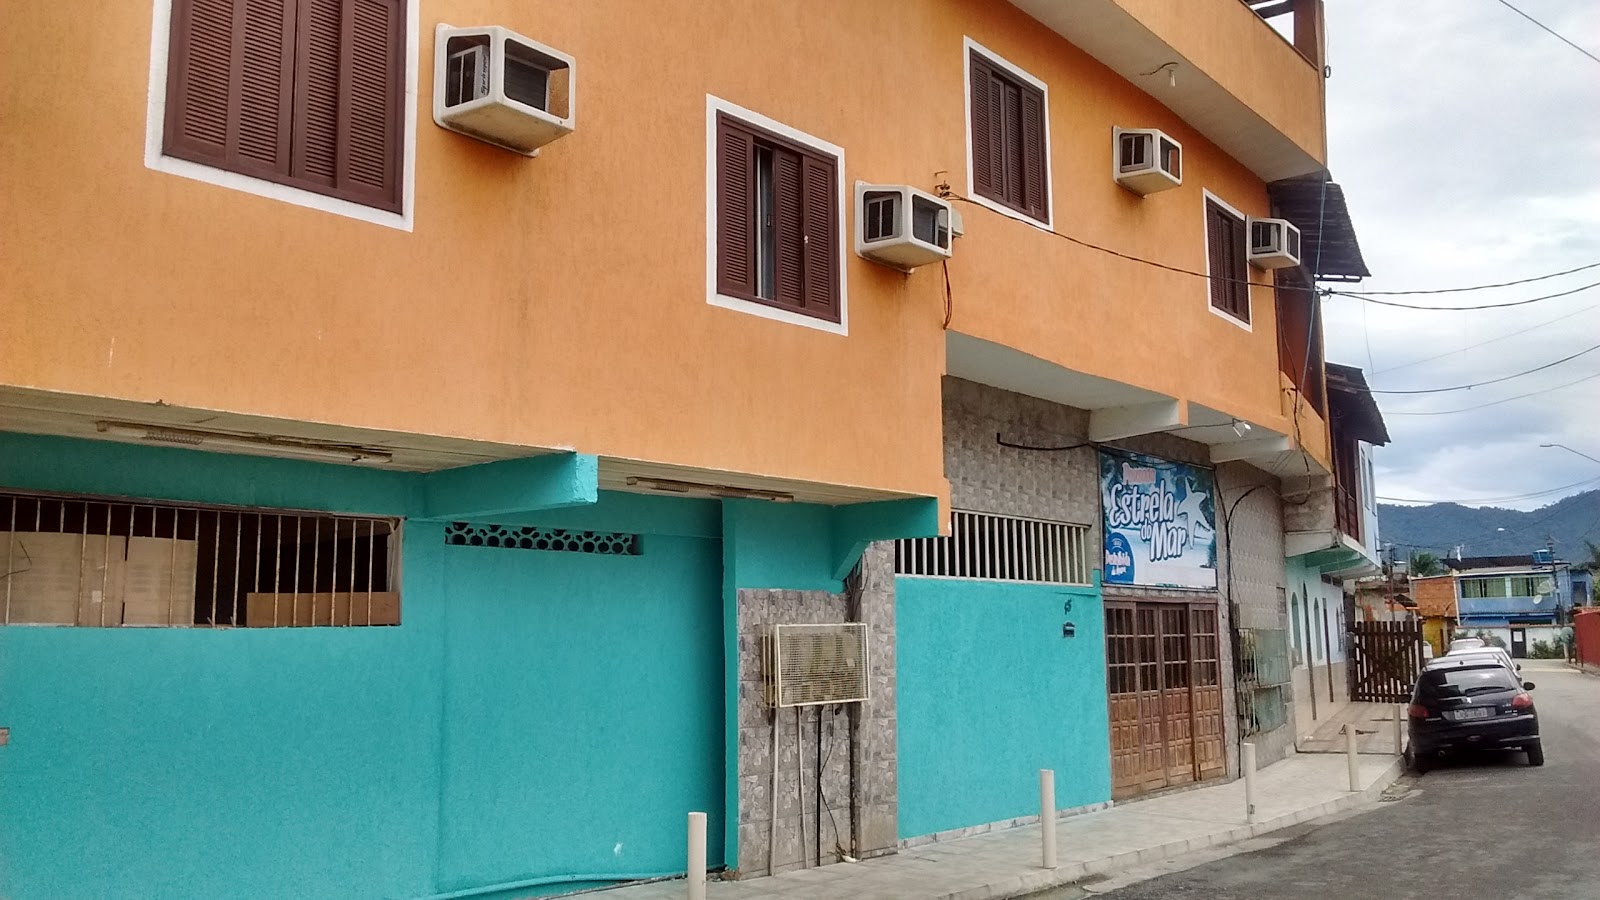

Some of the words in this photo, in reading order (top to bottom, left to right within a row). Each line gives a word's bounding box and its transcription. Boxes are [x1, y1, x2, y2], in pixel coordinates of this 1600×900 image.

[1110, 479, 1175, 527] Estrela
[1141, 518, 1152, 540] do
[1151, 522, 1186, 561] Mar
